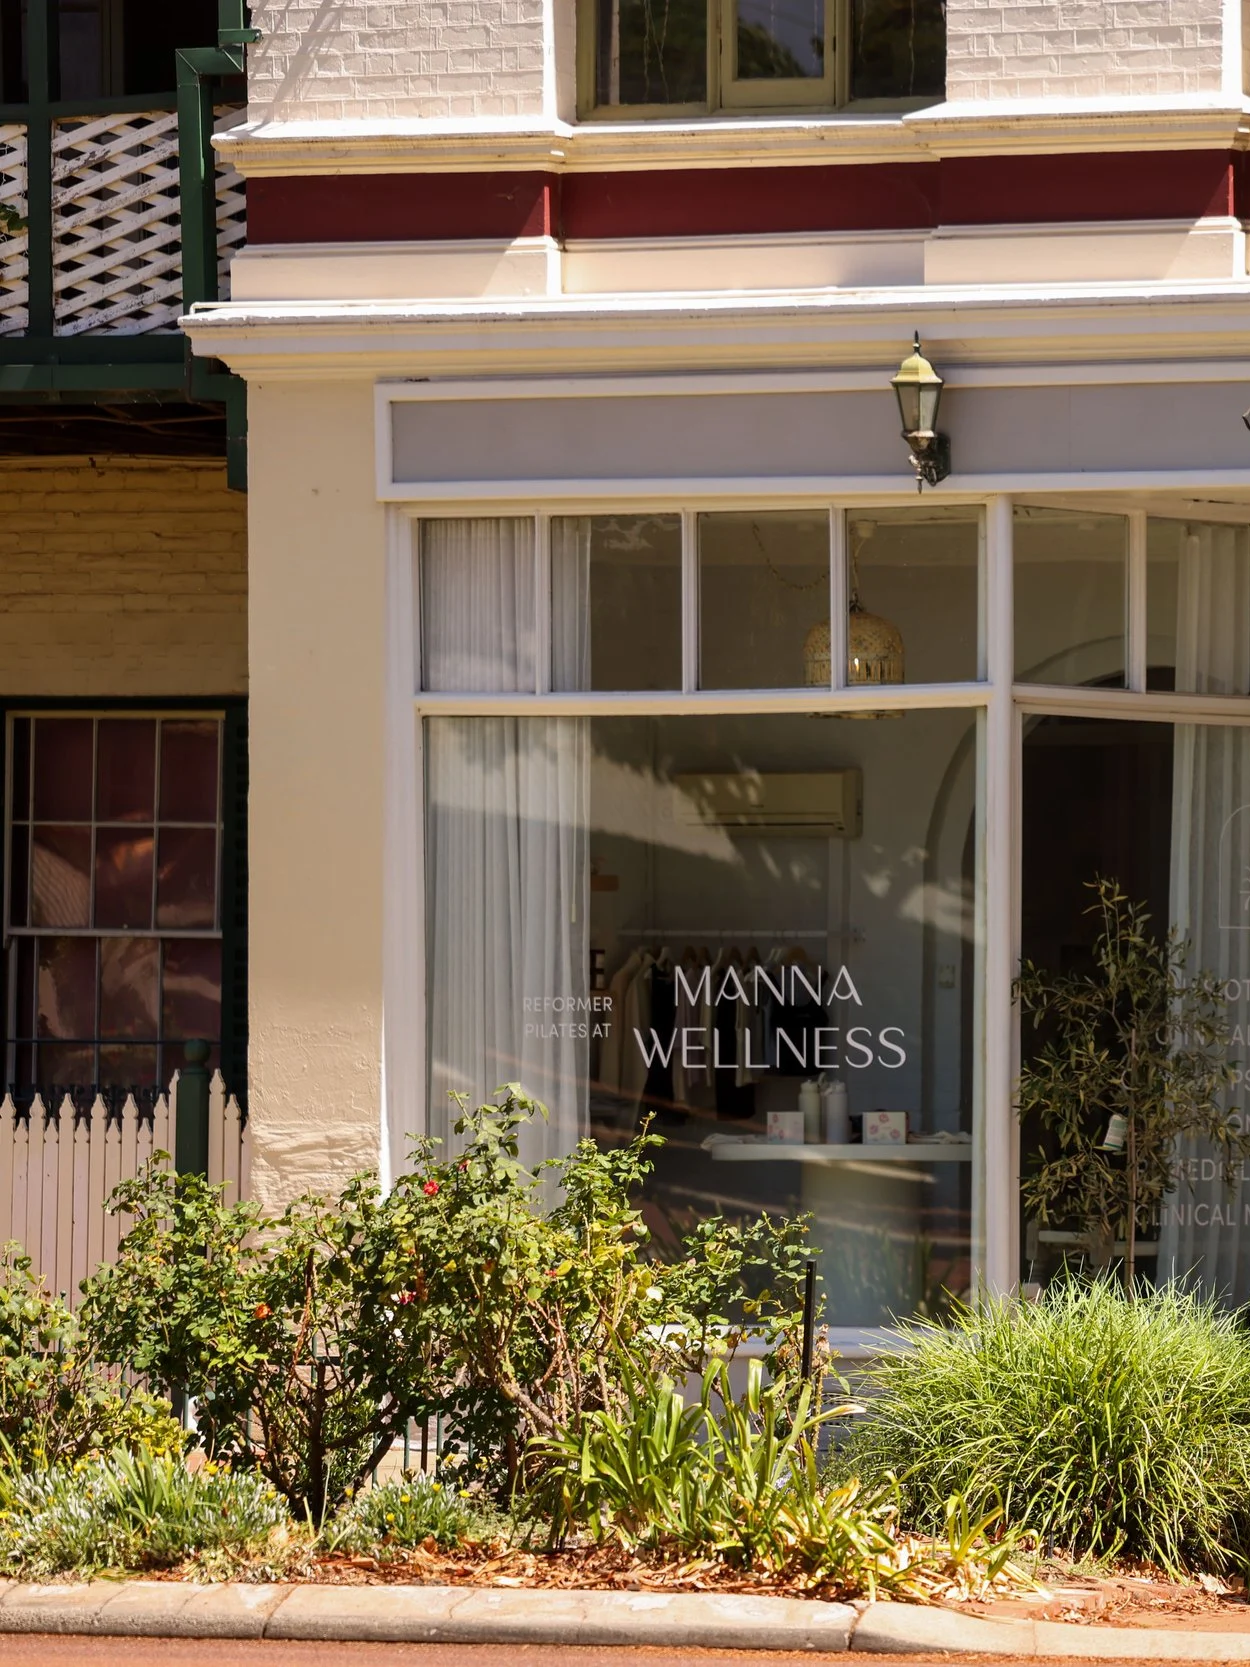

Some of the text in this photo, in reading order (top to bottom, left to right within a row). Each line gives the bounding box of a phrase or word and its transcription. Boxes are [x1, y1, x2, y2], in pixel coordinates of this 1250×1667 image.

[673, 964, 863, 1007] MANNA
[522, 996, 613, 1012] REFORMER
[524, 1023, 612, 1038] PILATES AT
[633, 1027, 907, 1069] WELLNESS
